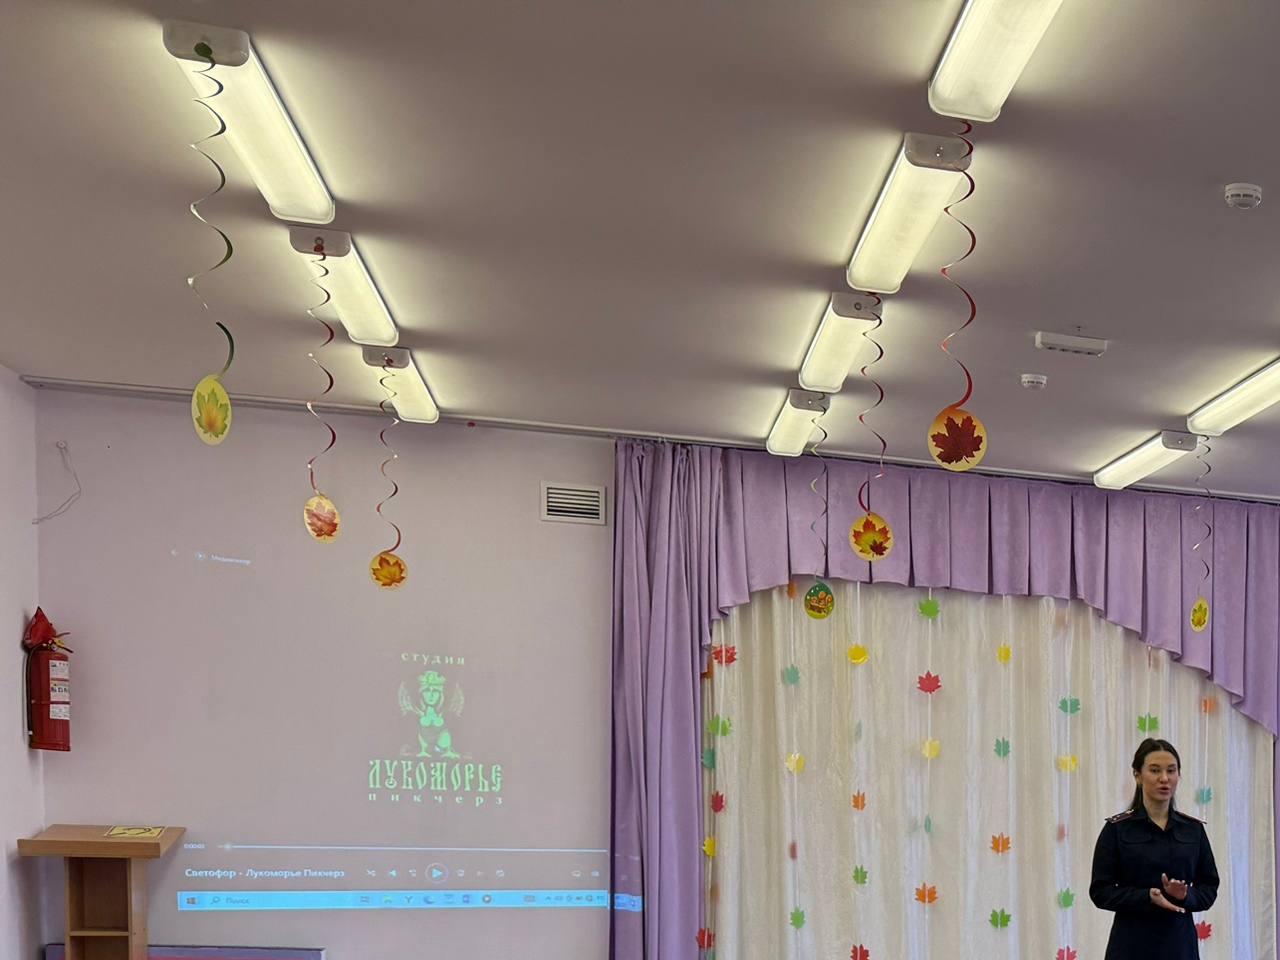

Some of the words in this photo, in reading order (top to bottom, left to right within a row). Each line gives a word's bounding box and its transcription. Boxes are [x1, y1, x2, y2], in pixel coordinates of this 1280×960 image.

[401, 652, 465, 666] студия
[368, 759, 503, 792] ЛУКОМОРЬЕ
[368, 793, 503, 807] пикчерз
[184, 868, 237, 879] Светофор
[246, 868, 302, 879] Лукоморье
[303, 869, 345, 879] Пикчерз
